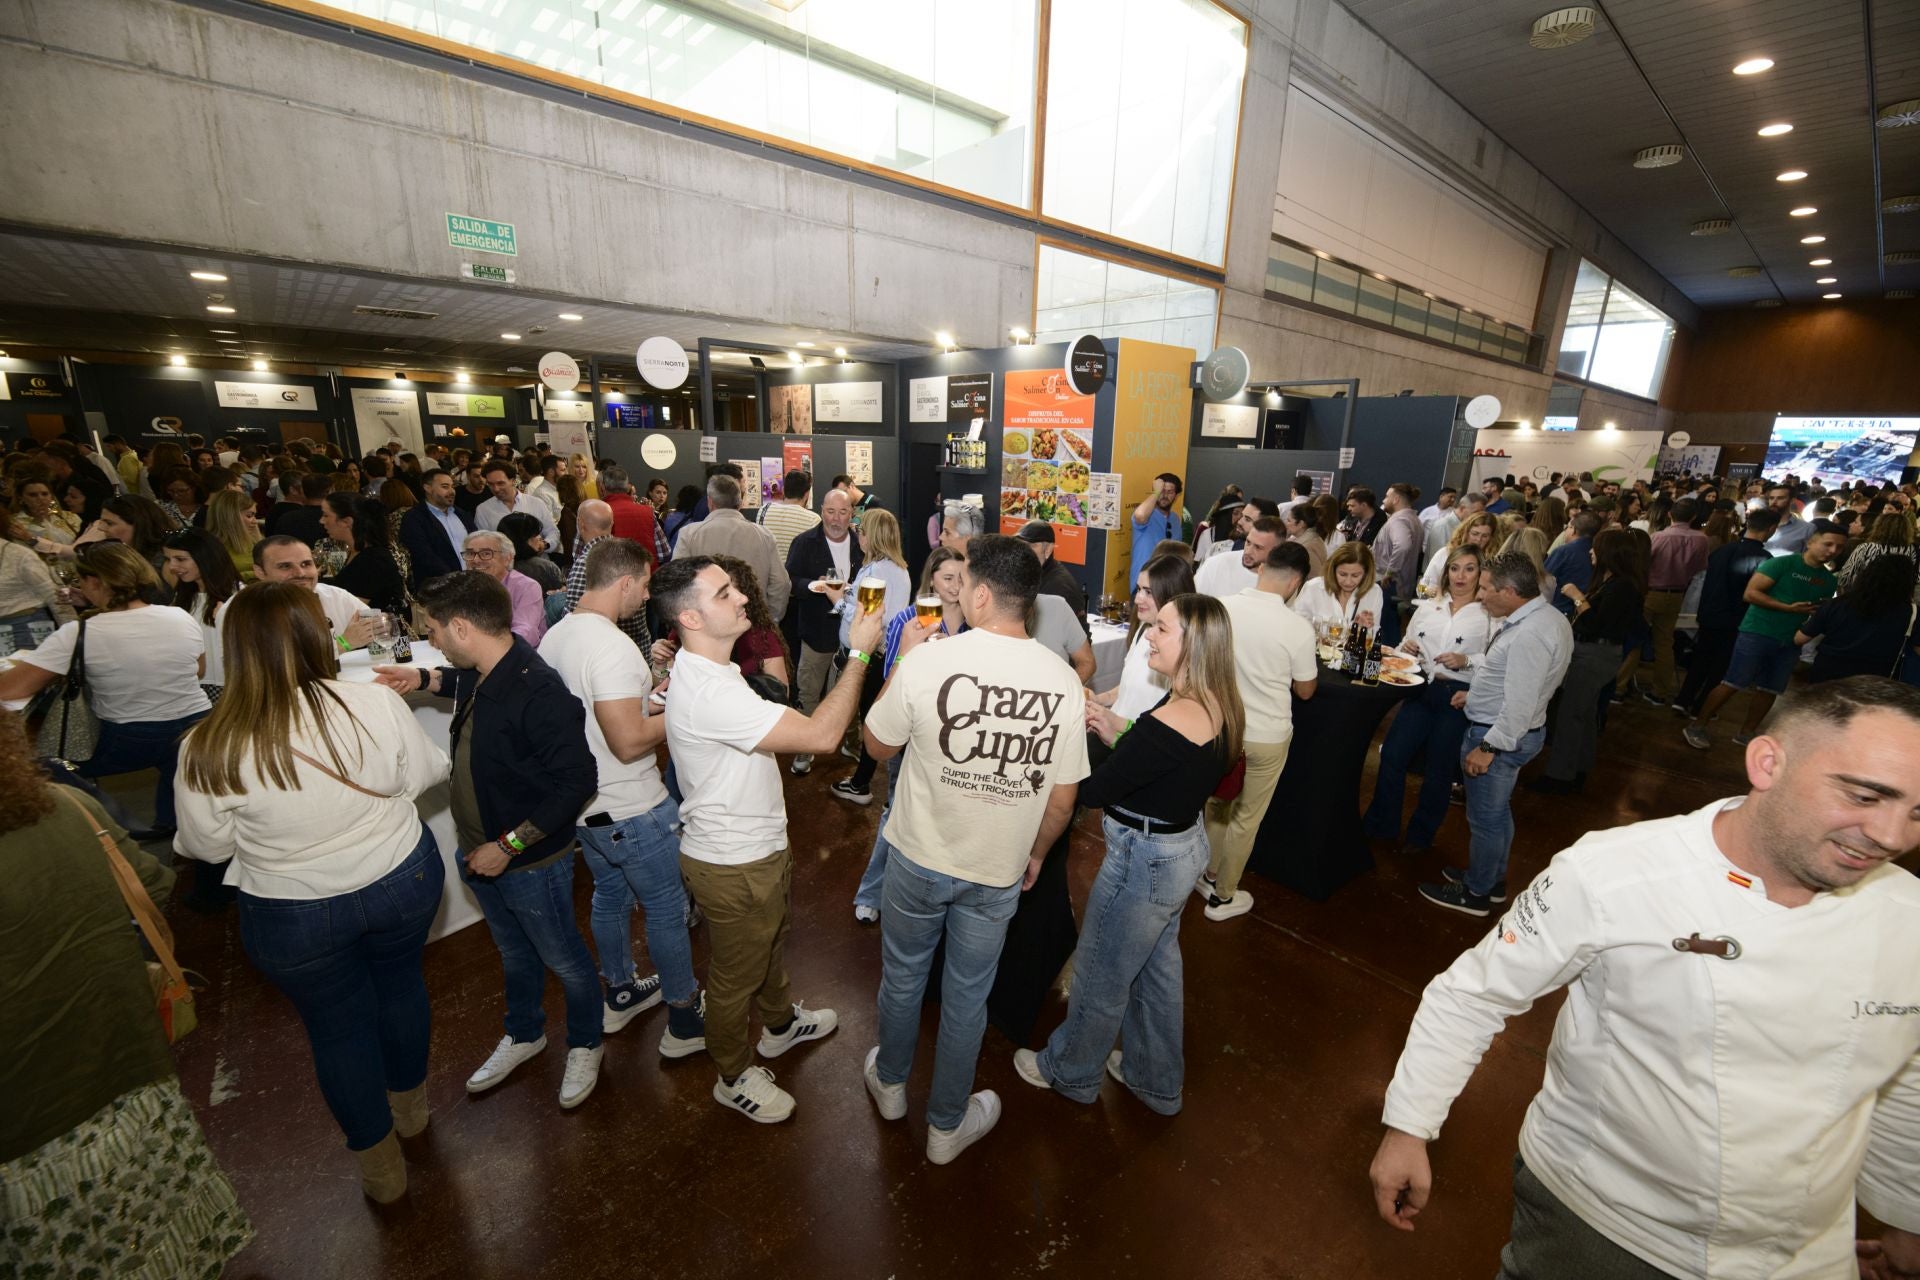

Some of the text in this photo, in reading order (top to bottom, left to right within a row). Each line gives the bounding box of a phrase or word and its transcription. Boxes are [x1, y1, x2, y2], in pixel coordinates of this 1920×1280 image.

[451, 217, 511, 238] SALIDA DE
[450, 231, 515, 253] EMERGENCIA
[1128, 368, 1144, 400] LA
[936, 672, 1065, 736] Crazy
[938, 712, 1060, 778] Cupid
[940, 775, 1031, 799] STRUCK TRICKSTER
[942, 766, 1020, 789] CUPID THE LOVE
